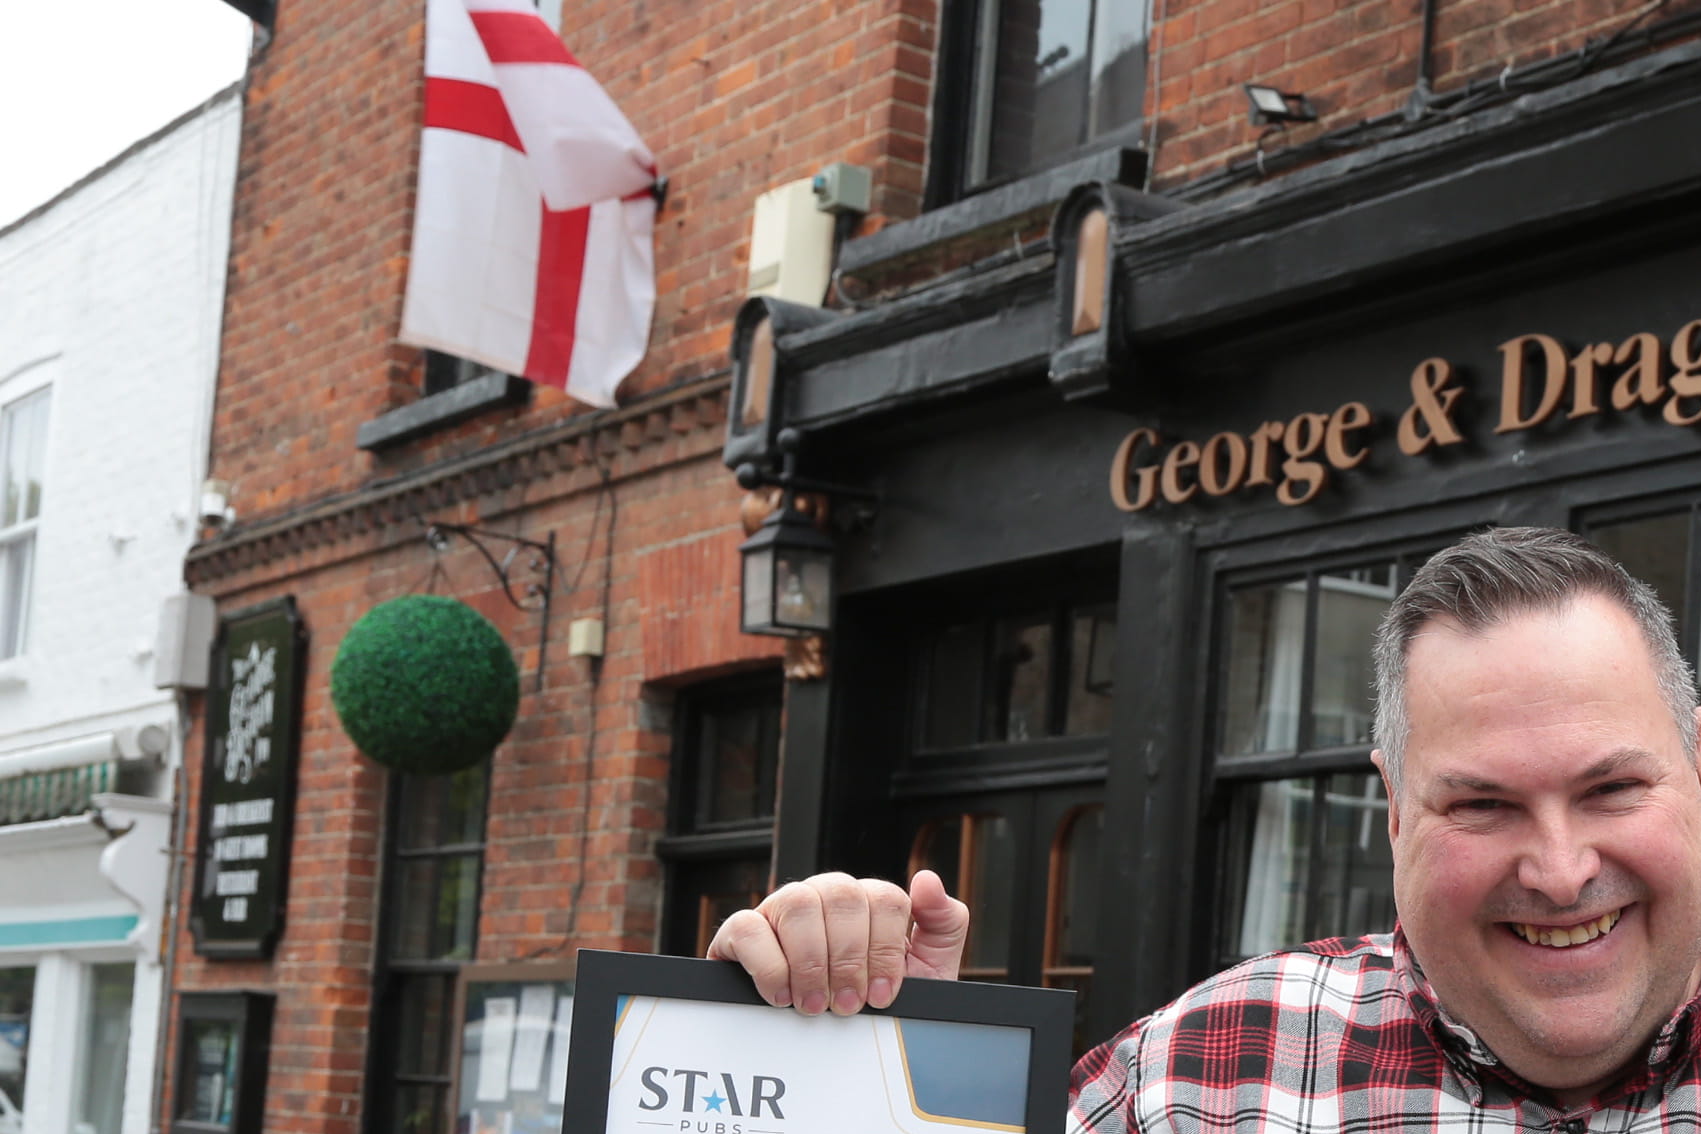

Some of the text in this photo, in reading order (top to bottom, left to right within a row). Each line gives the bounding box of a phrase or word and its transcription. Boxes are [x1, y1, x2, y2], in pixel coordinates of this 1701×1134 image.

[1108, 399, 1370, 512] George
[1395, 355, 1467, 457] &
[638, 1066, 786, 1120] STAR
